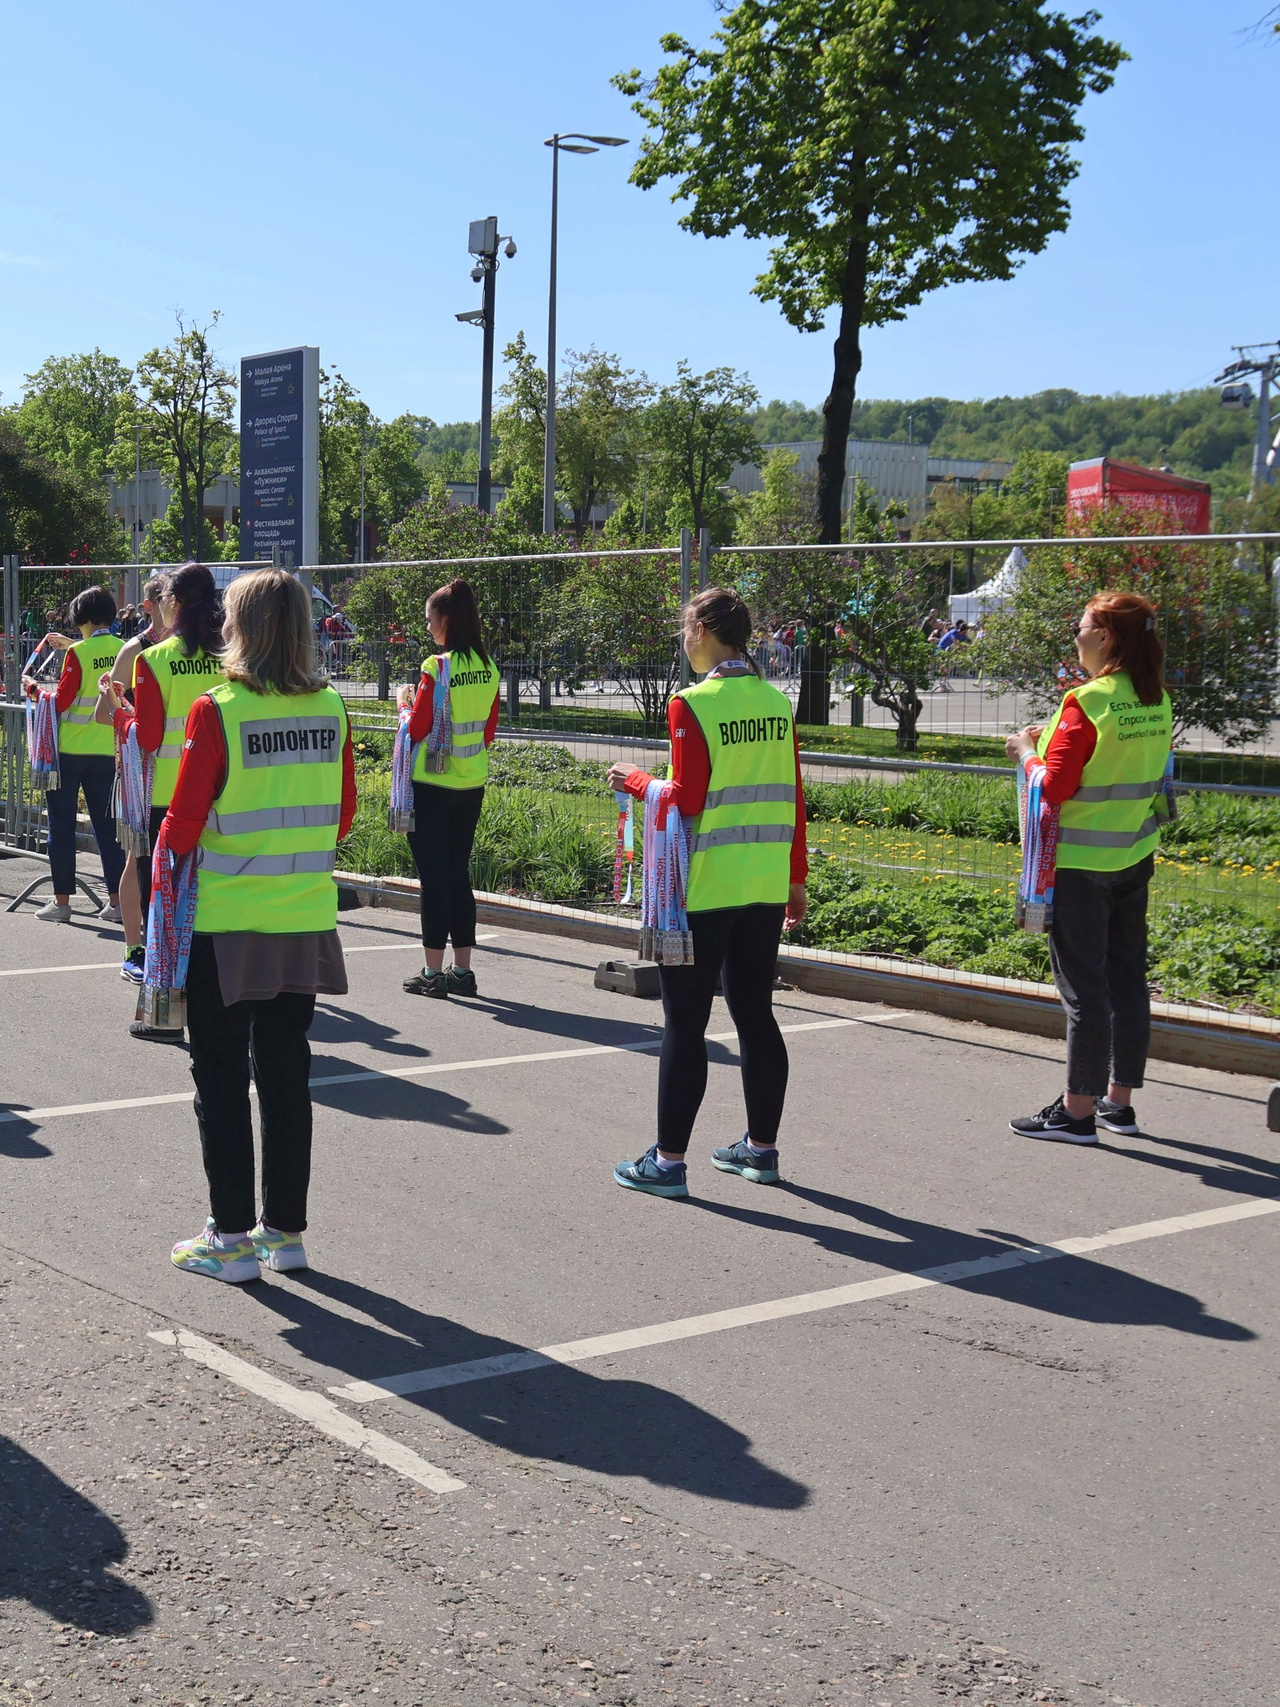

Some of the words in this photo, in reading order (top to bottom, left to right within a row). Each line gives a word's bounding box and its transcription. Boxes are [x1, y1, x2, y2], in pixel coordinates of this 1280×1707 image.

[254, 366, 273, 376] Малая
[274, 364, 292, 374] Арена
[254, 417, 276, 427] Дворец
[277, 414, 298, 423] Спорта
[254, 465, 295, 476] Аквакомплекс
[254, 519, 294, 527] Фестивальная
[93, 656, 116, 669] ВОЛО
[169, 659, 224, 676] ВОЛОНТ
[450, 670, 492, 687] ВОЛОНТЕР
[1110, 701, 1132, 711] Есть
[719, 717, 788, 746] ВОЛОНТЕР
[247, 728, 336, 755] ВОЛОНТЕР
